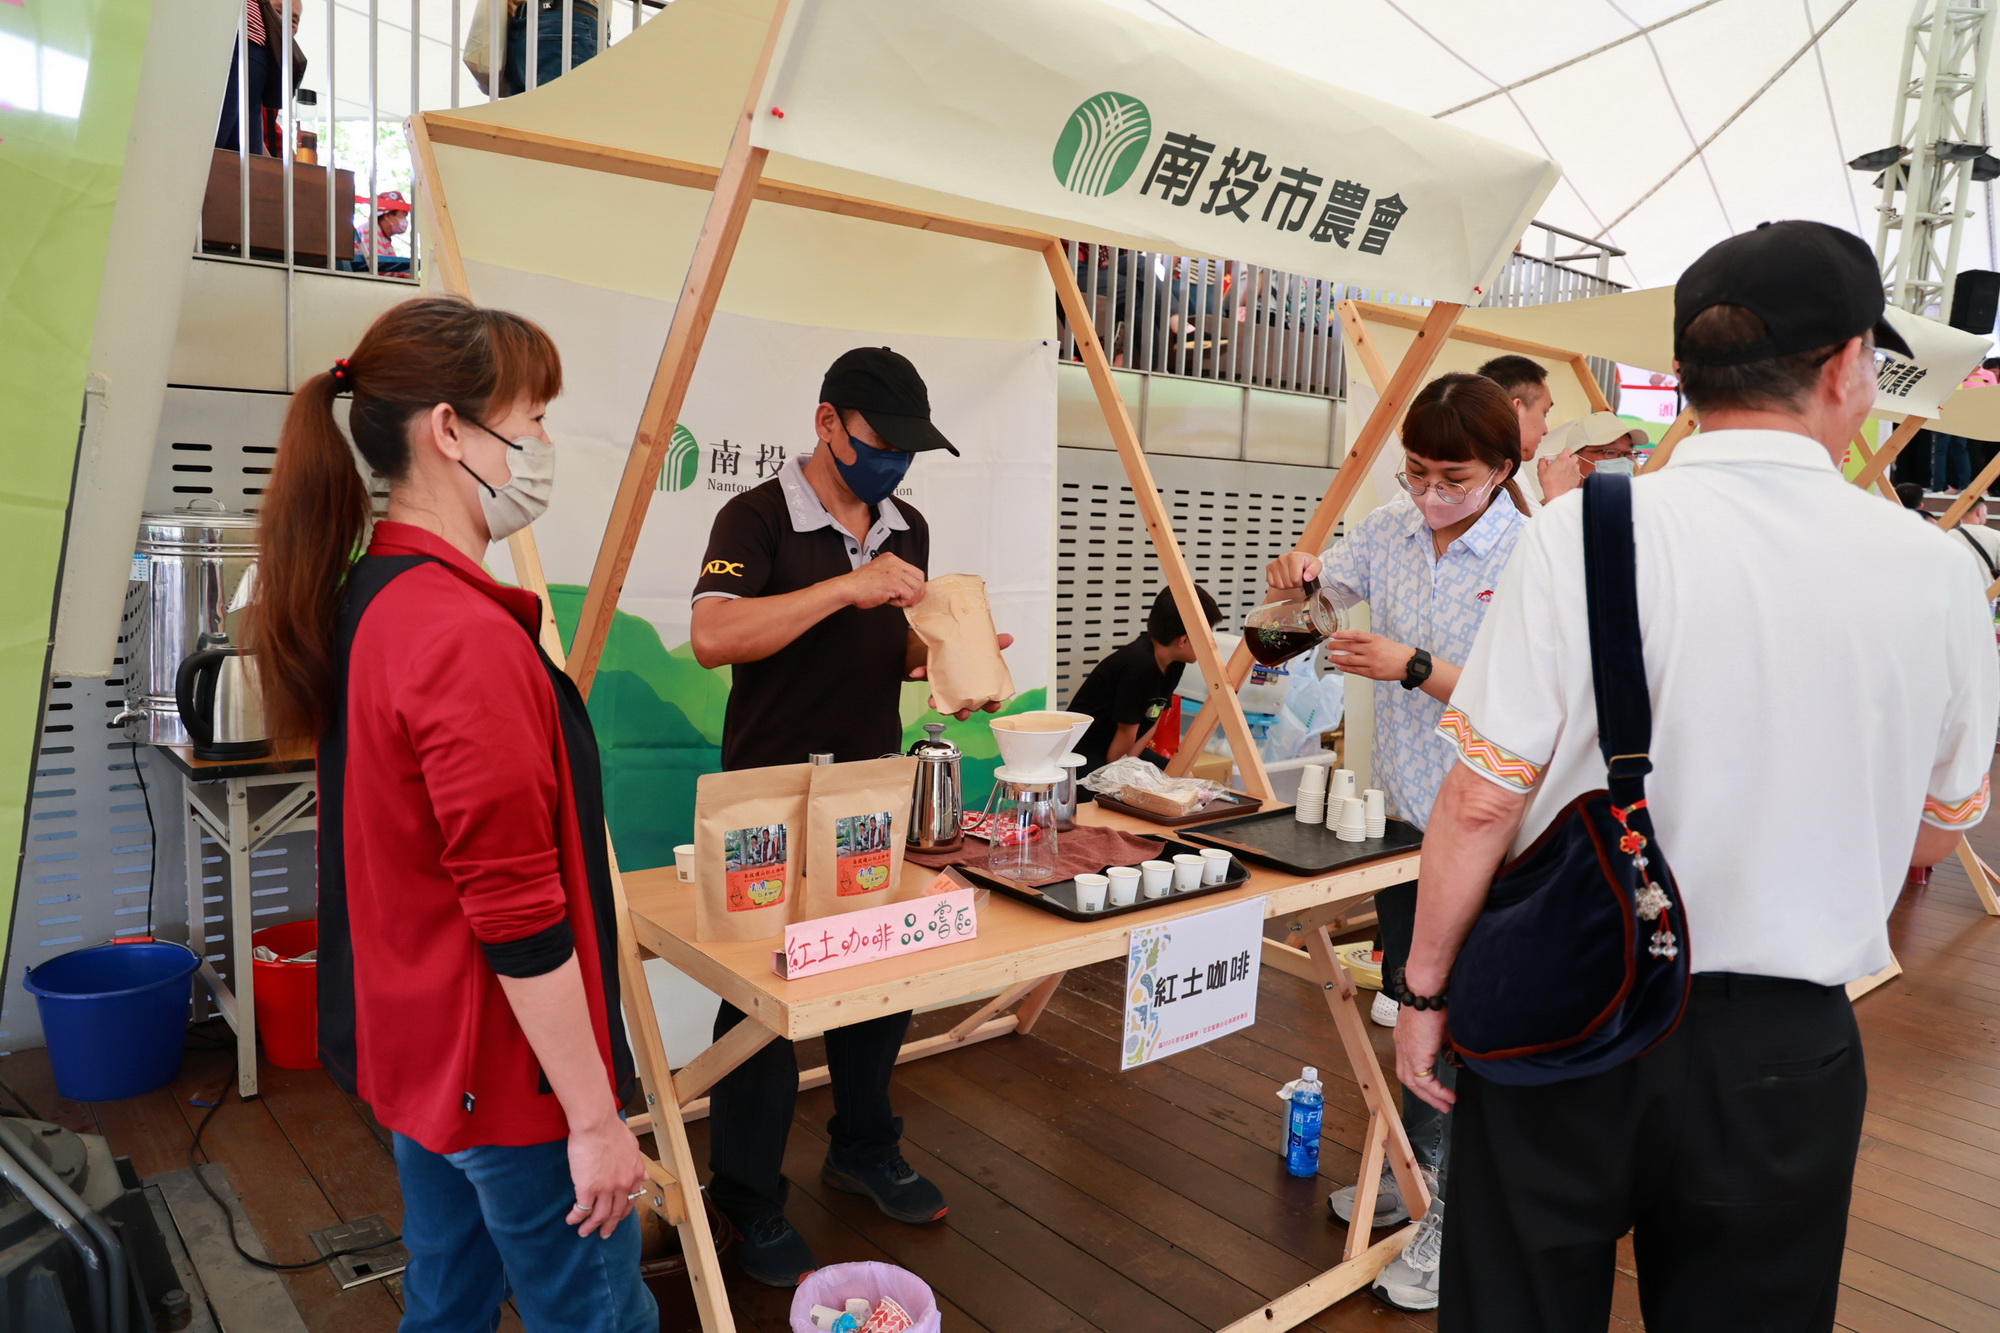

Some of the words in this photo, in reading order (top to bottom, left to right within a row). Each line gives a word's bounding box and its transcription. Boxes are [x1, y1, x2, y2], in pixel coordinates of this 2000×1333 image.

[1139, 131, 1409, 256] 南投市農會
[709, 439, 813, 479] 南投
[707, 478, 752, 493] Nantou
[890, 487, 913, 496] ion
[1153, 950, 1250, 1008] 紅土咖啡
